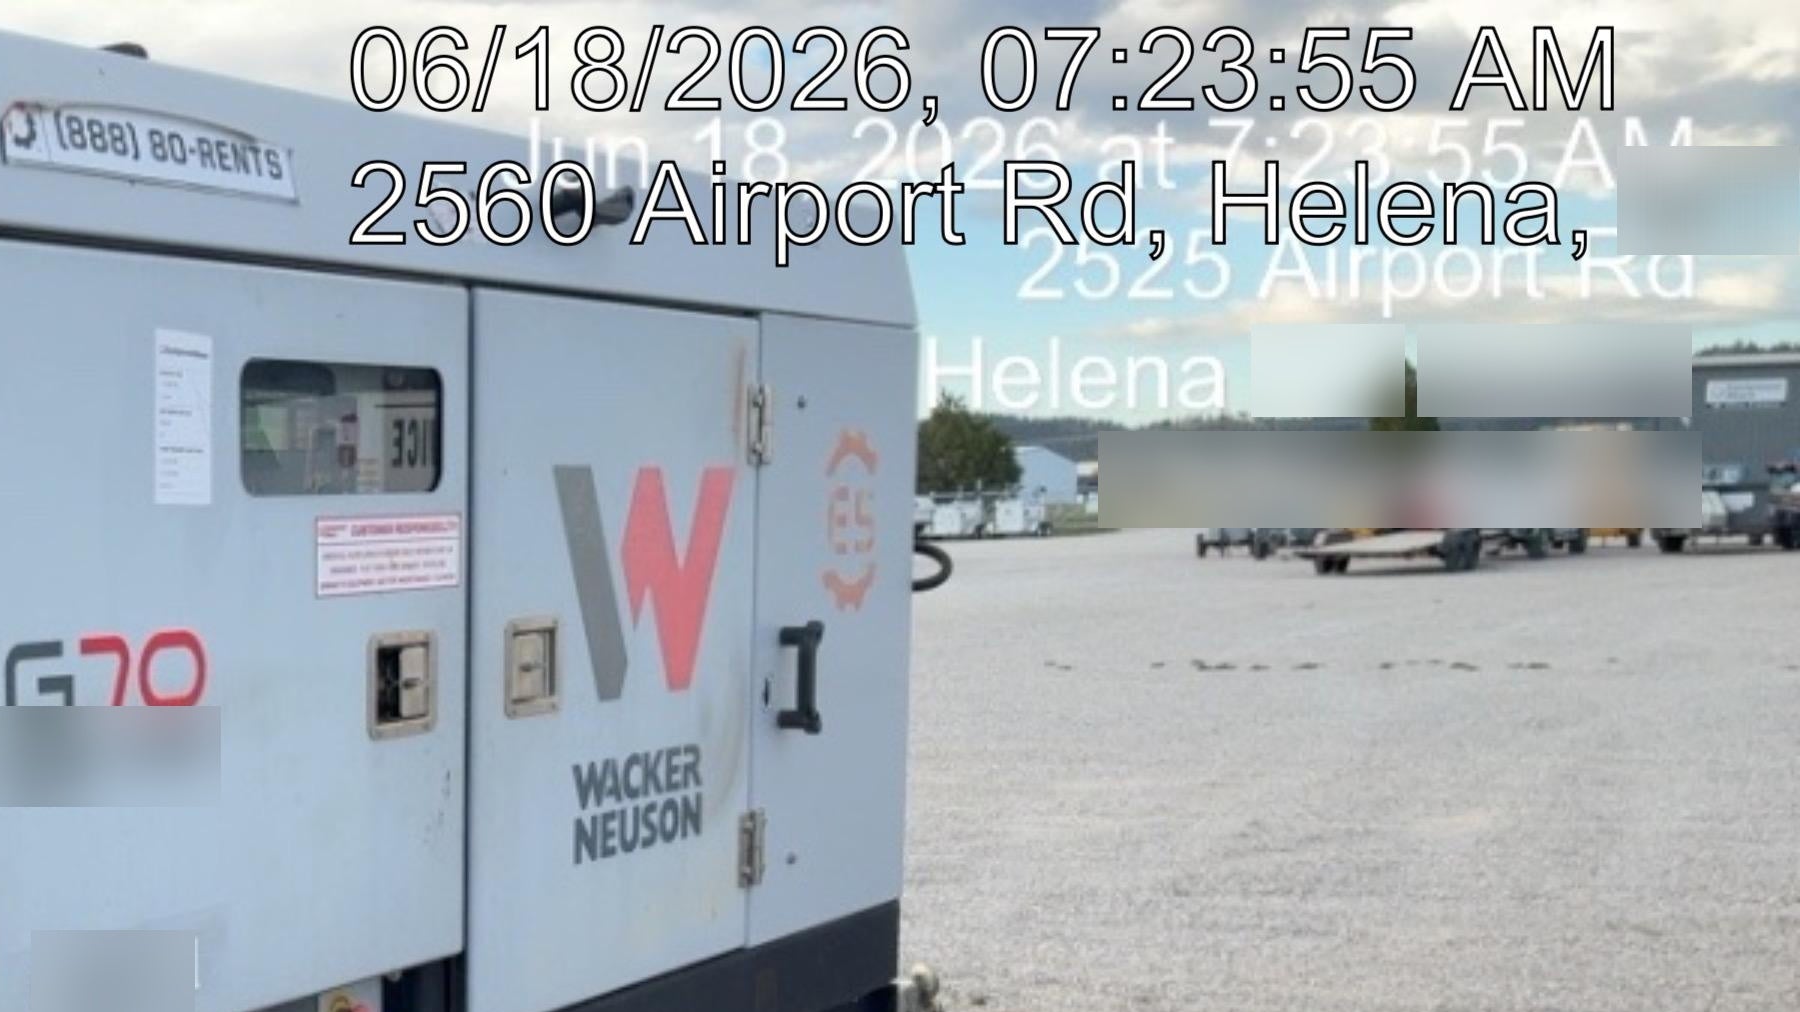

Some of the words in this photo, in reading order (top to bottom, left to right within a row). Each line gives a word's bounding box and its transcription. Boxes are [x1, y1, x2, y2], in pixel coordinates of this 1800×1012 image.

[54, 108, 140, 162] (888)
[148, 128, 284, 181] 80-RENTS
[572, 743, 702, 809] WACKER
[573, 793, 702, 866] NEUSON
